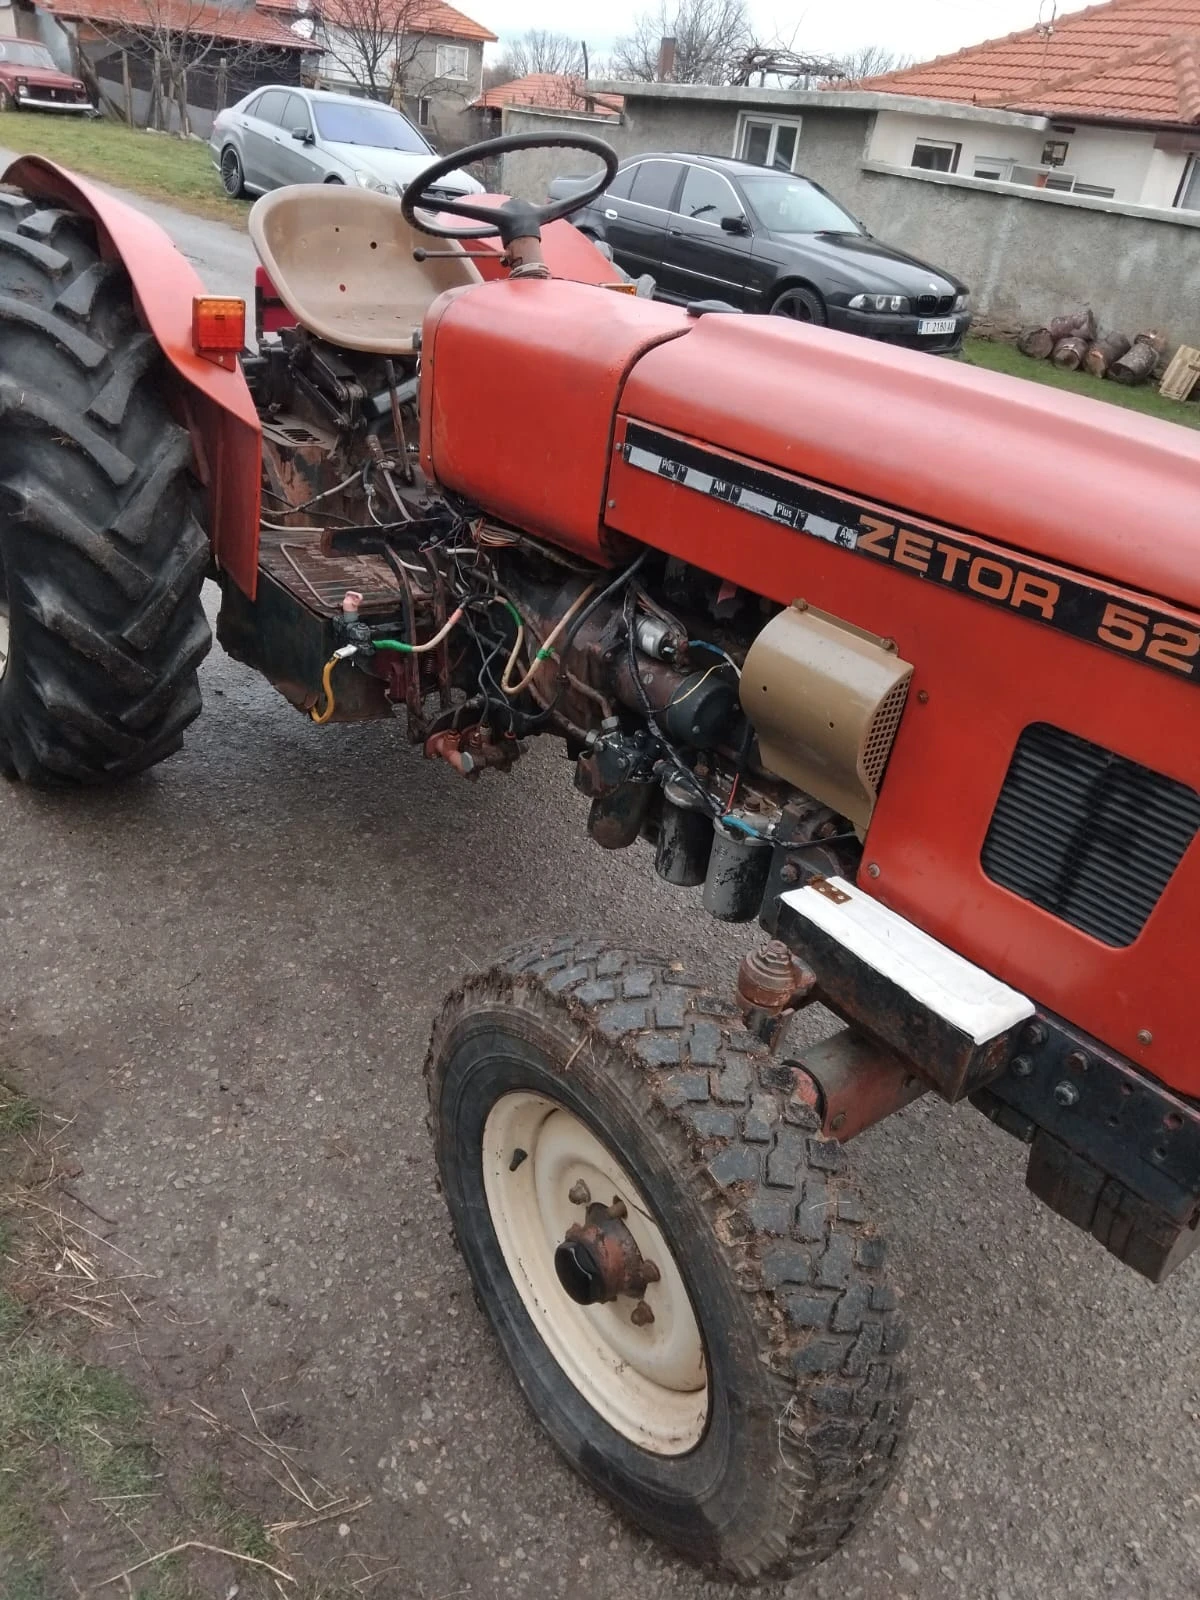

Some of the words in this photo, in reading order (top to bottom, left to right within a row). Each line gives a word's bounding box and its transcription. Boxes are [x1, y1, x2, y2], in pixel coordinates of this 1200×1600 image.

[776, 503, 792, 518] Plus
[856, 514, 1061, 620] ZETOR
[1098, 602, 1200, 674] 52
